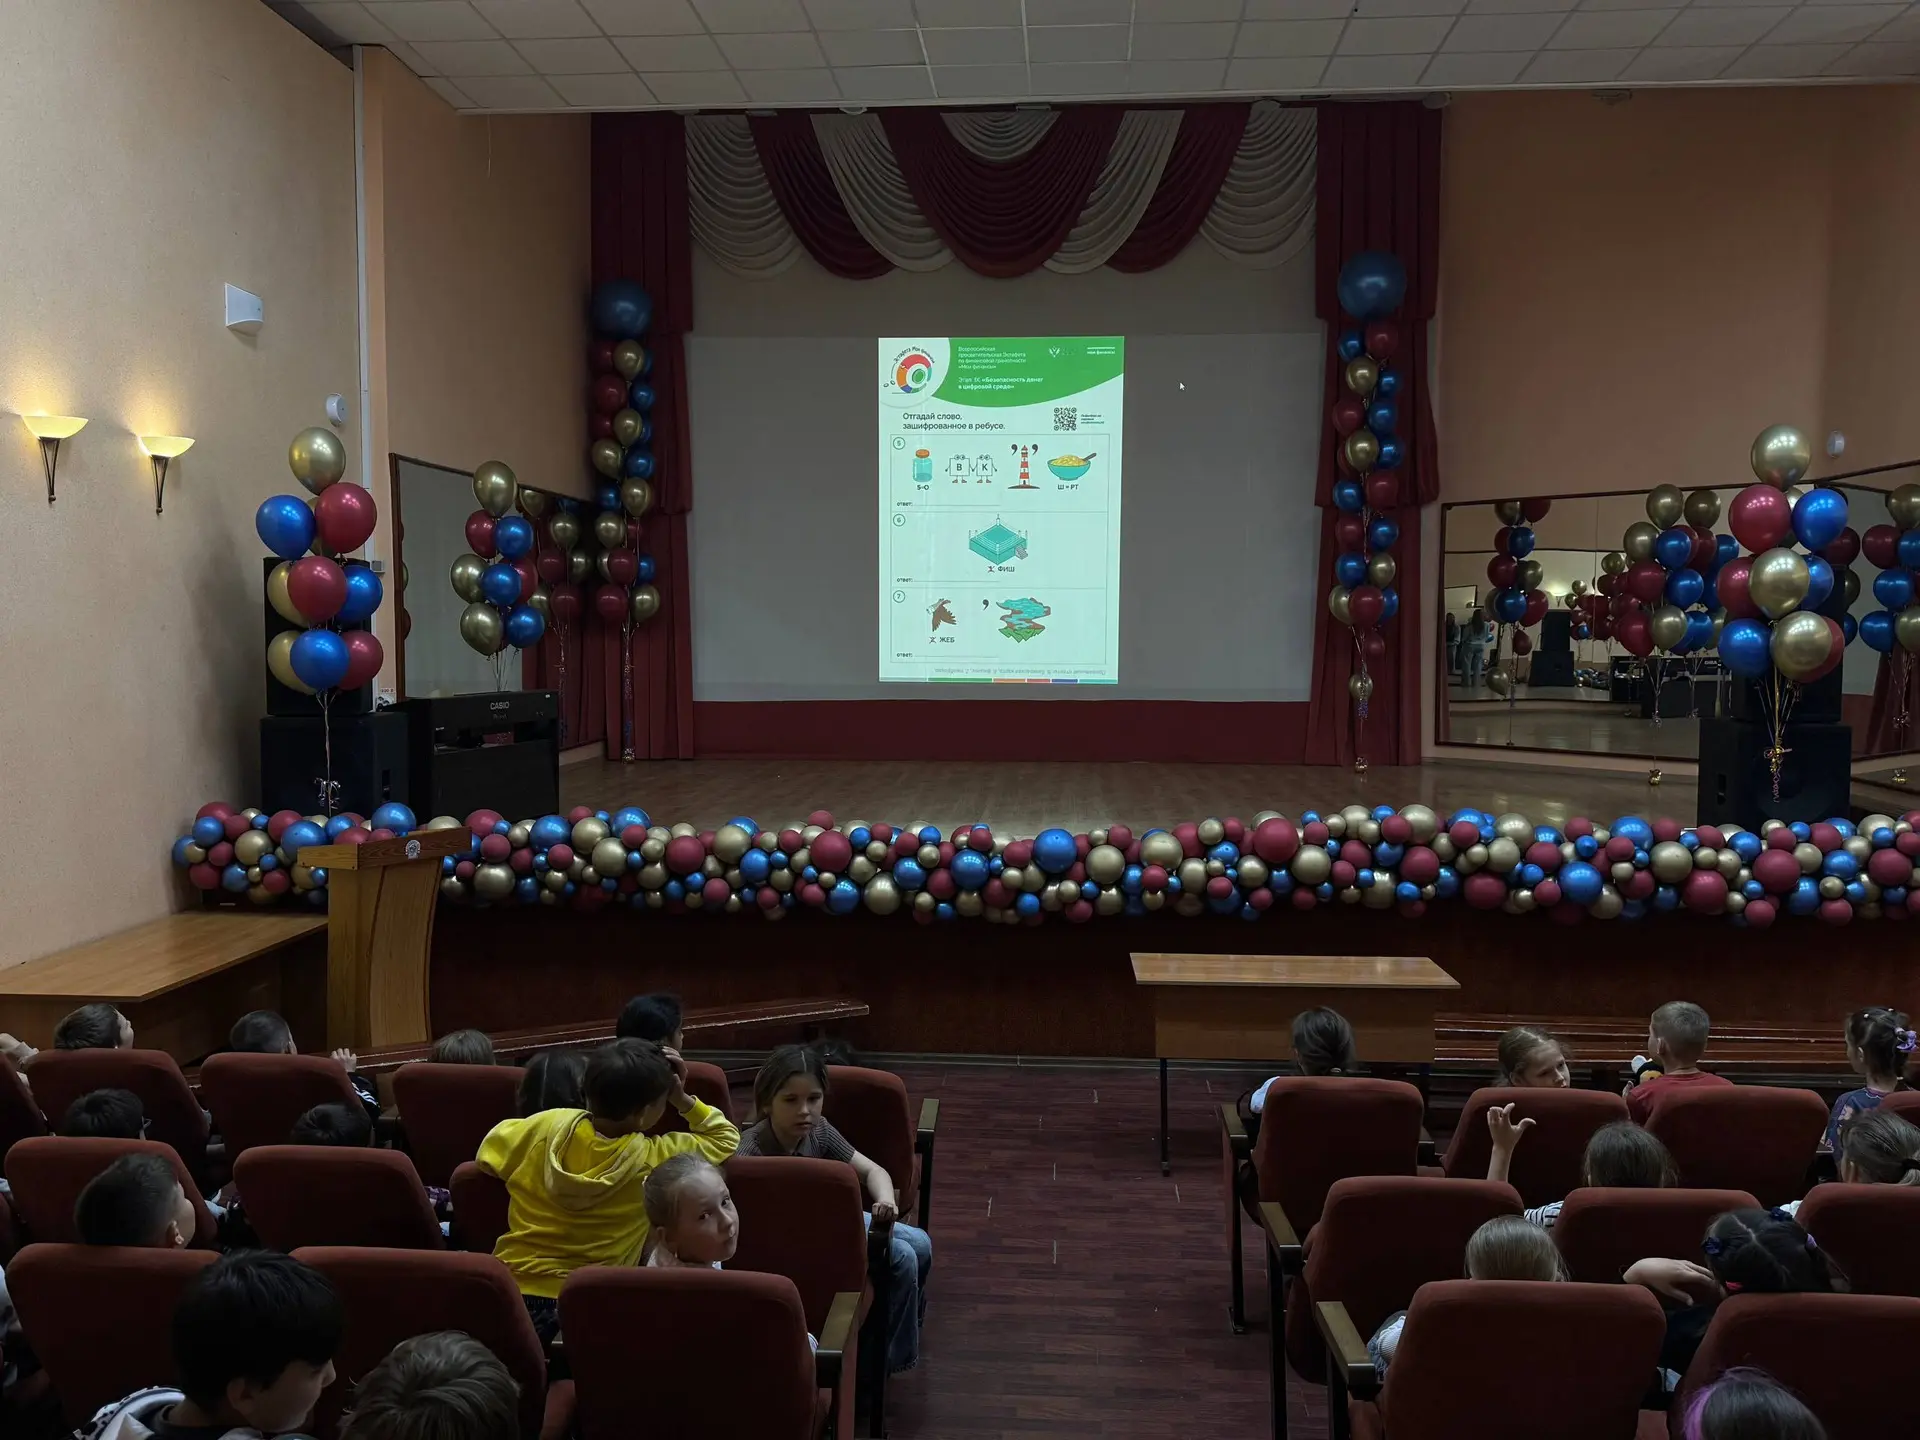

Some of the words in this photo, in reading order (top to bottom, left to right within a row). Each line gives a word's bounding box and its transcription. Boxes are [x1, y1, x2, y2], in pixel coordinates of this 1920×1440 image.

[902, 412, 936, 421] Отгадай
[936, 413, 963, 421] слово,
[902, 422, 967, 431] зашифрованное
[974, 422, 1006, 431] ребусе.
[490, 701, 510, 710] CASIO
